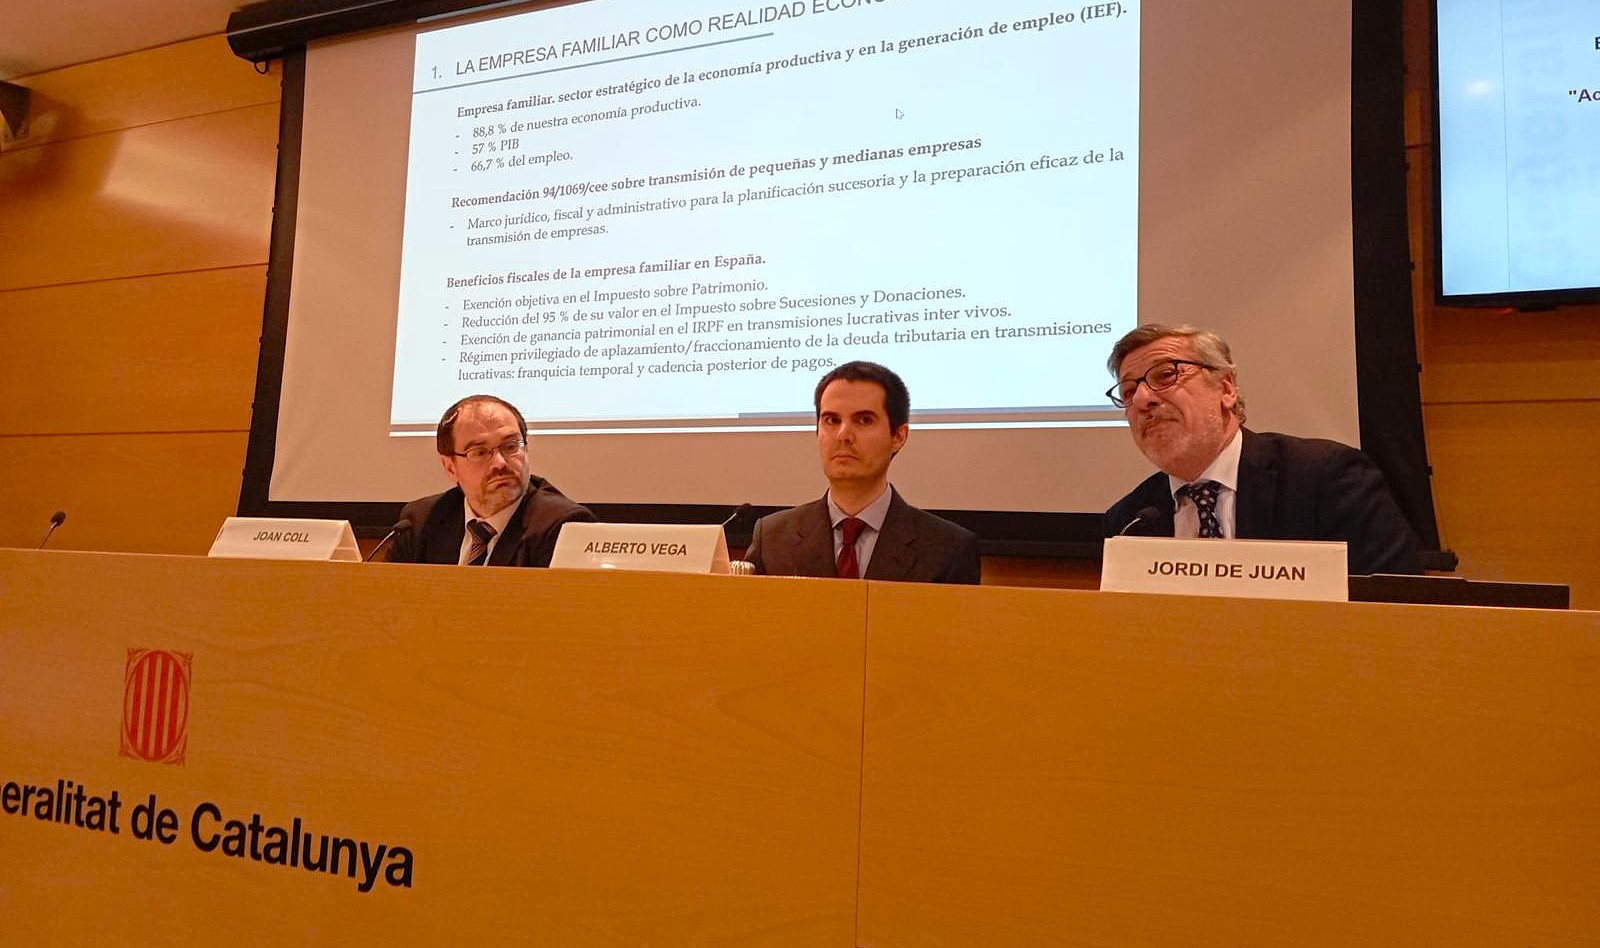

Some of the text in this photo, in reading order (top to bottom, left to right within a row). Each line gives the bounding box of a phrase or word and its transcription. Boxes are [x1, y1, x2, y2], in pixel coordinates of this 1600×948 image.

[431, 65, 443, 80] 1.
[456, 59, 476, 76] LA
[478, 45, 558, 72] EMPRESA
[561, 30, 641, 60] FAMILIAR
[645, 19, 703, 43] COMO
[708, 1, 806, 33] REALIDAD
[457, 100, 504, 119] Empresa
[557, 88, 594, 105] sector
[595, 77, 661, 97] estratégico
[664, 74, 680, 87] de
[682, 71, 695, 84] la
[698, 61, 762, 81] economía
[765, 49, 842, 75] productiva
[844, 48, 855, 63] y
[858, 45, 877, 56] en
[880, 40, 894, 53] la
[898, 25, 985, 54] generación
[988, 21, 1008, 35] de
[1012, 12, 1075, 32] empleo
[1080, 1, 1128, 24] (IEF).
[472, 96, 702, 140] 88,8 % de nuestra economía productiva.
[470, 149, 573, 172] 66,7 % del empleo.
[471, 138, 520, 156] 57 % PIB
[451, 138, 982, 208] Recomendación 94/1069/cee sobre transmisión de pequeñas y medianas empresas
[467, 147, 1125, 230] Marco jurídico, fiscal y administrativo para la planificación sucesoria y la preparación eficaz de la
[467, 225, 609, 247] transmisión de empresas.
[446, 253, 766, 291] Beneficios fiscales de la empresa familiar en España.
[461, 287, 966, 329] Reducción del 95 % de su valor en el Impuesto sobre Sucesiones y Donaciones.
[462, 279, 768, 311] Exención objetiva en el Impuesto sobre Patrimonio.
[459, 321, 1112, 366] Régimen privilegiado de aplazamiento/fraccionamiento de la deuda tributaria en transmisiones
[460, 305, 1012, 348] Exención de ganancia patrimonial en el IRPF en transmisiones lucrativas inter vivos.
[458, 356, 837, 382] lucrativas: franquicia temporal y cadencia posterior de pagos.
[253, 531, 310, 543] JOAN COLL
[584, 541, 688, 556] ALBERTO VEGA
[1147, 561, 1306, 581] JORDI DE JUAN
[0, 779, 413, 893] eralitat de Catalunya
